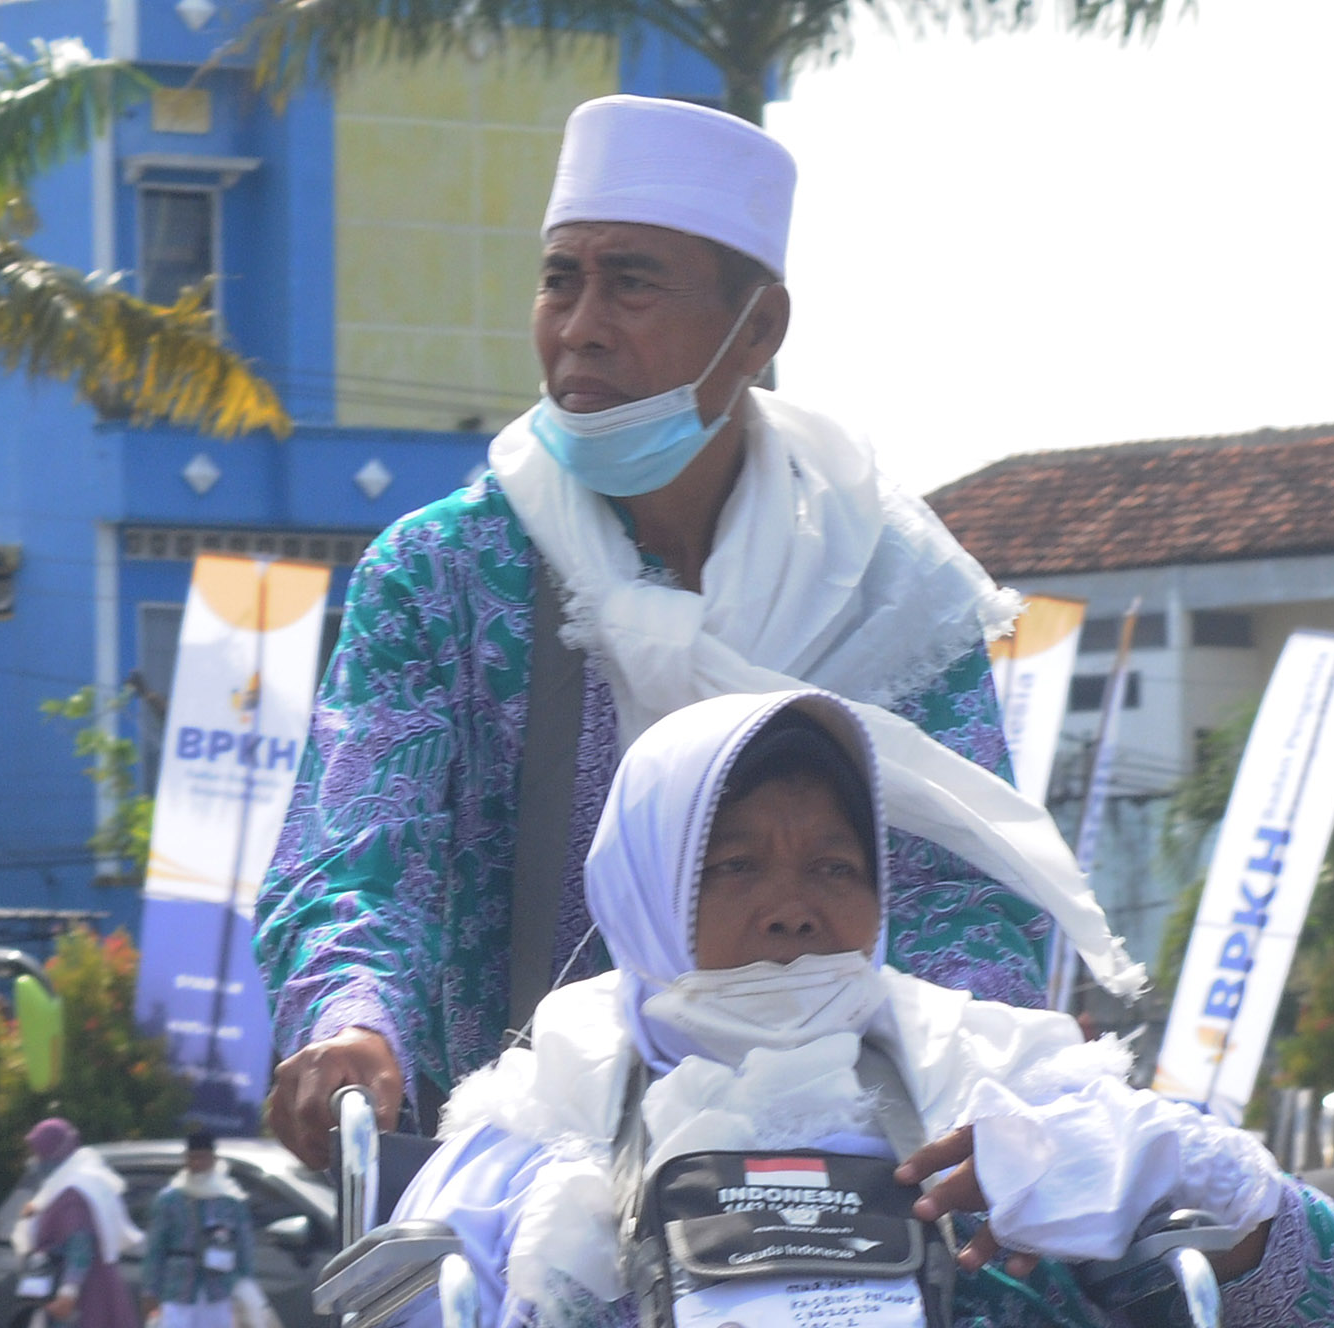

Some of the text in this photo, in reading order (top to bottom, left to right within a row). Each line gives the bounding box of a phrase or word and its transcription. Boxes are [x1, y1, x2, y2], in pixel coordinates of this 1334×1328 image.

[175, 726, 298, 771] BPKH
[1202, 825, 1292, 1020] BPKH
[718, 1186, 864, 1206] INDONESIA
[784, 1244, 856, 1259] Indonesia
